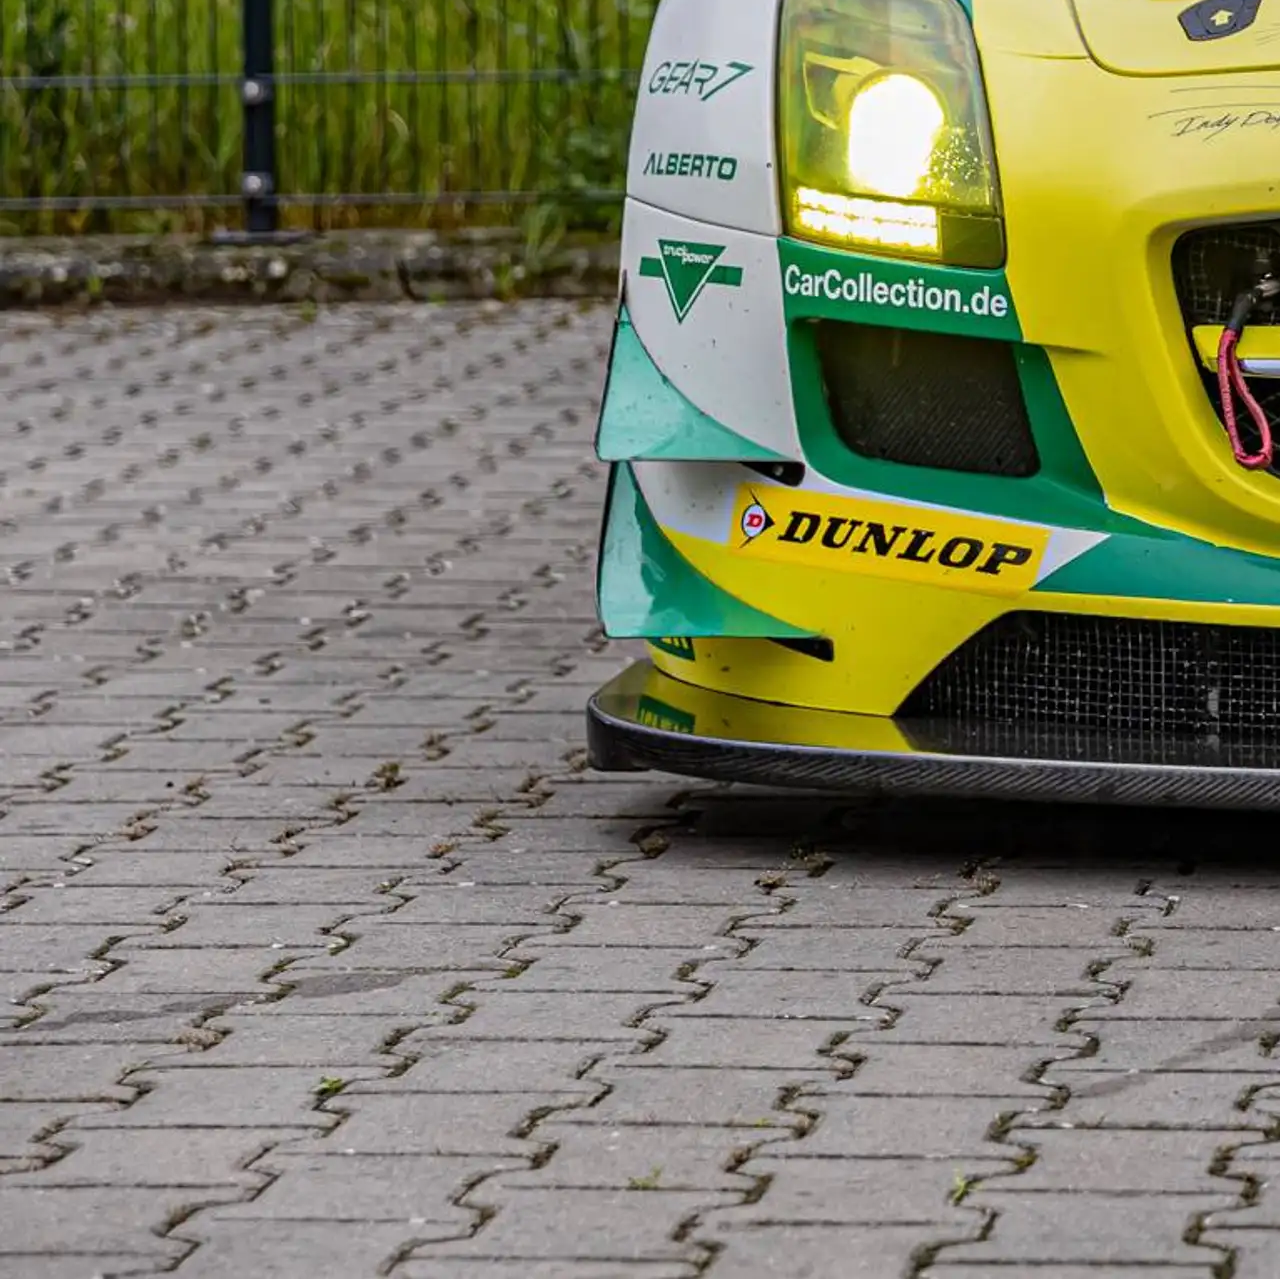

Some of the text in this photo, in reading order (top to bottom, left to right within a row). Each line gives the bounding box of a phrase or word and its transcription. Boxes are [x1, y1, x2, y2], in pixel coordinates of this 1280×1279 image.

[643, 151, 737, 181] ALBERTO
[784, 265, 1008, 317] CarCollection.de
[778, 510, 1033, 576] DUNLOP
